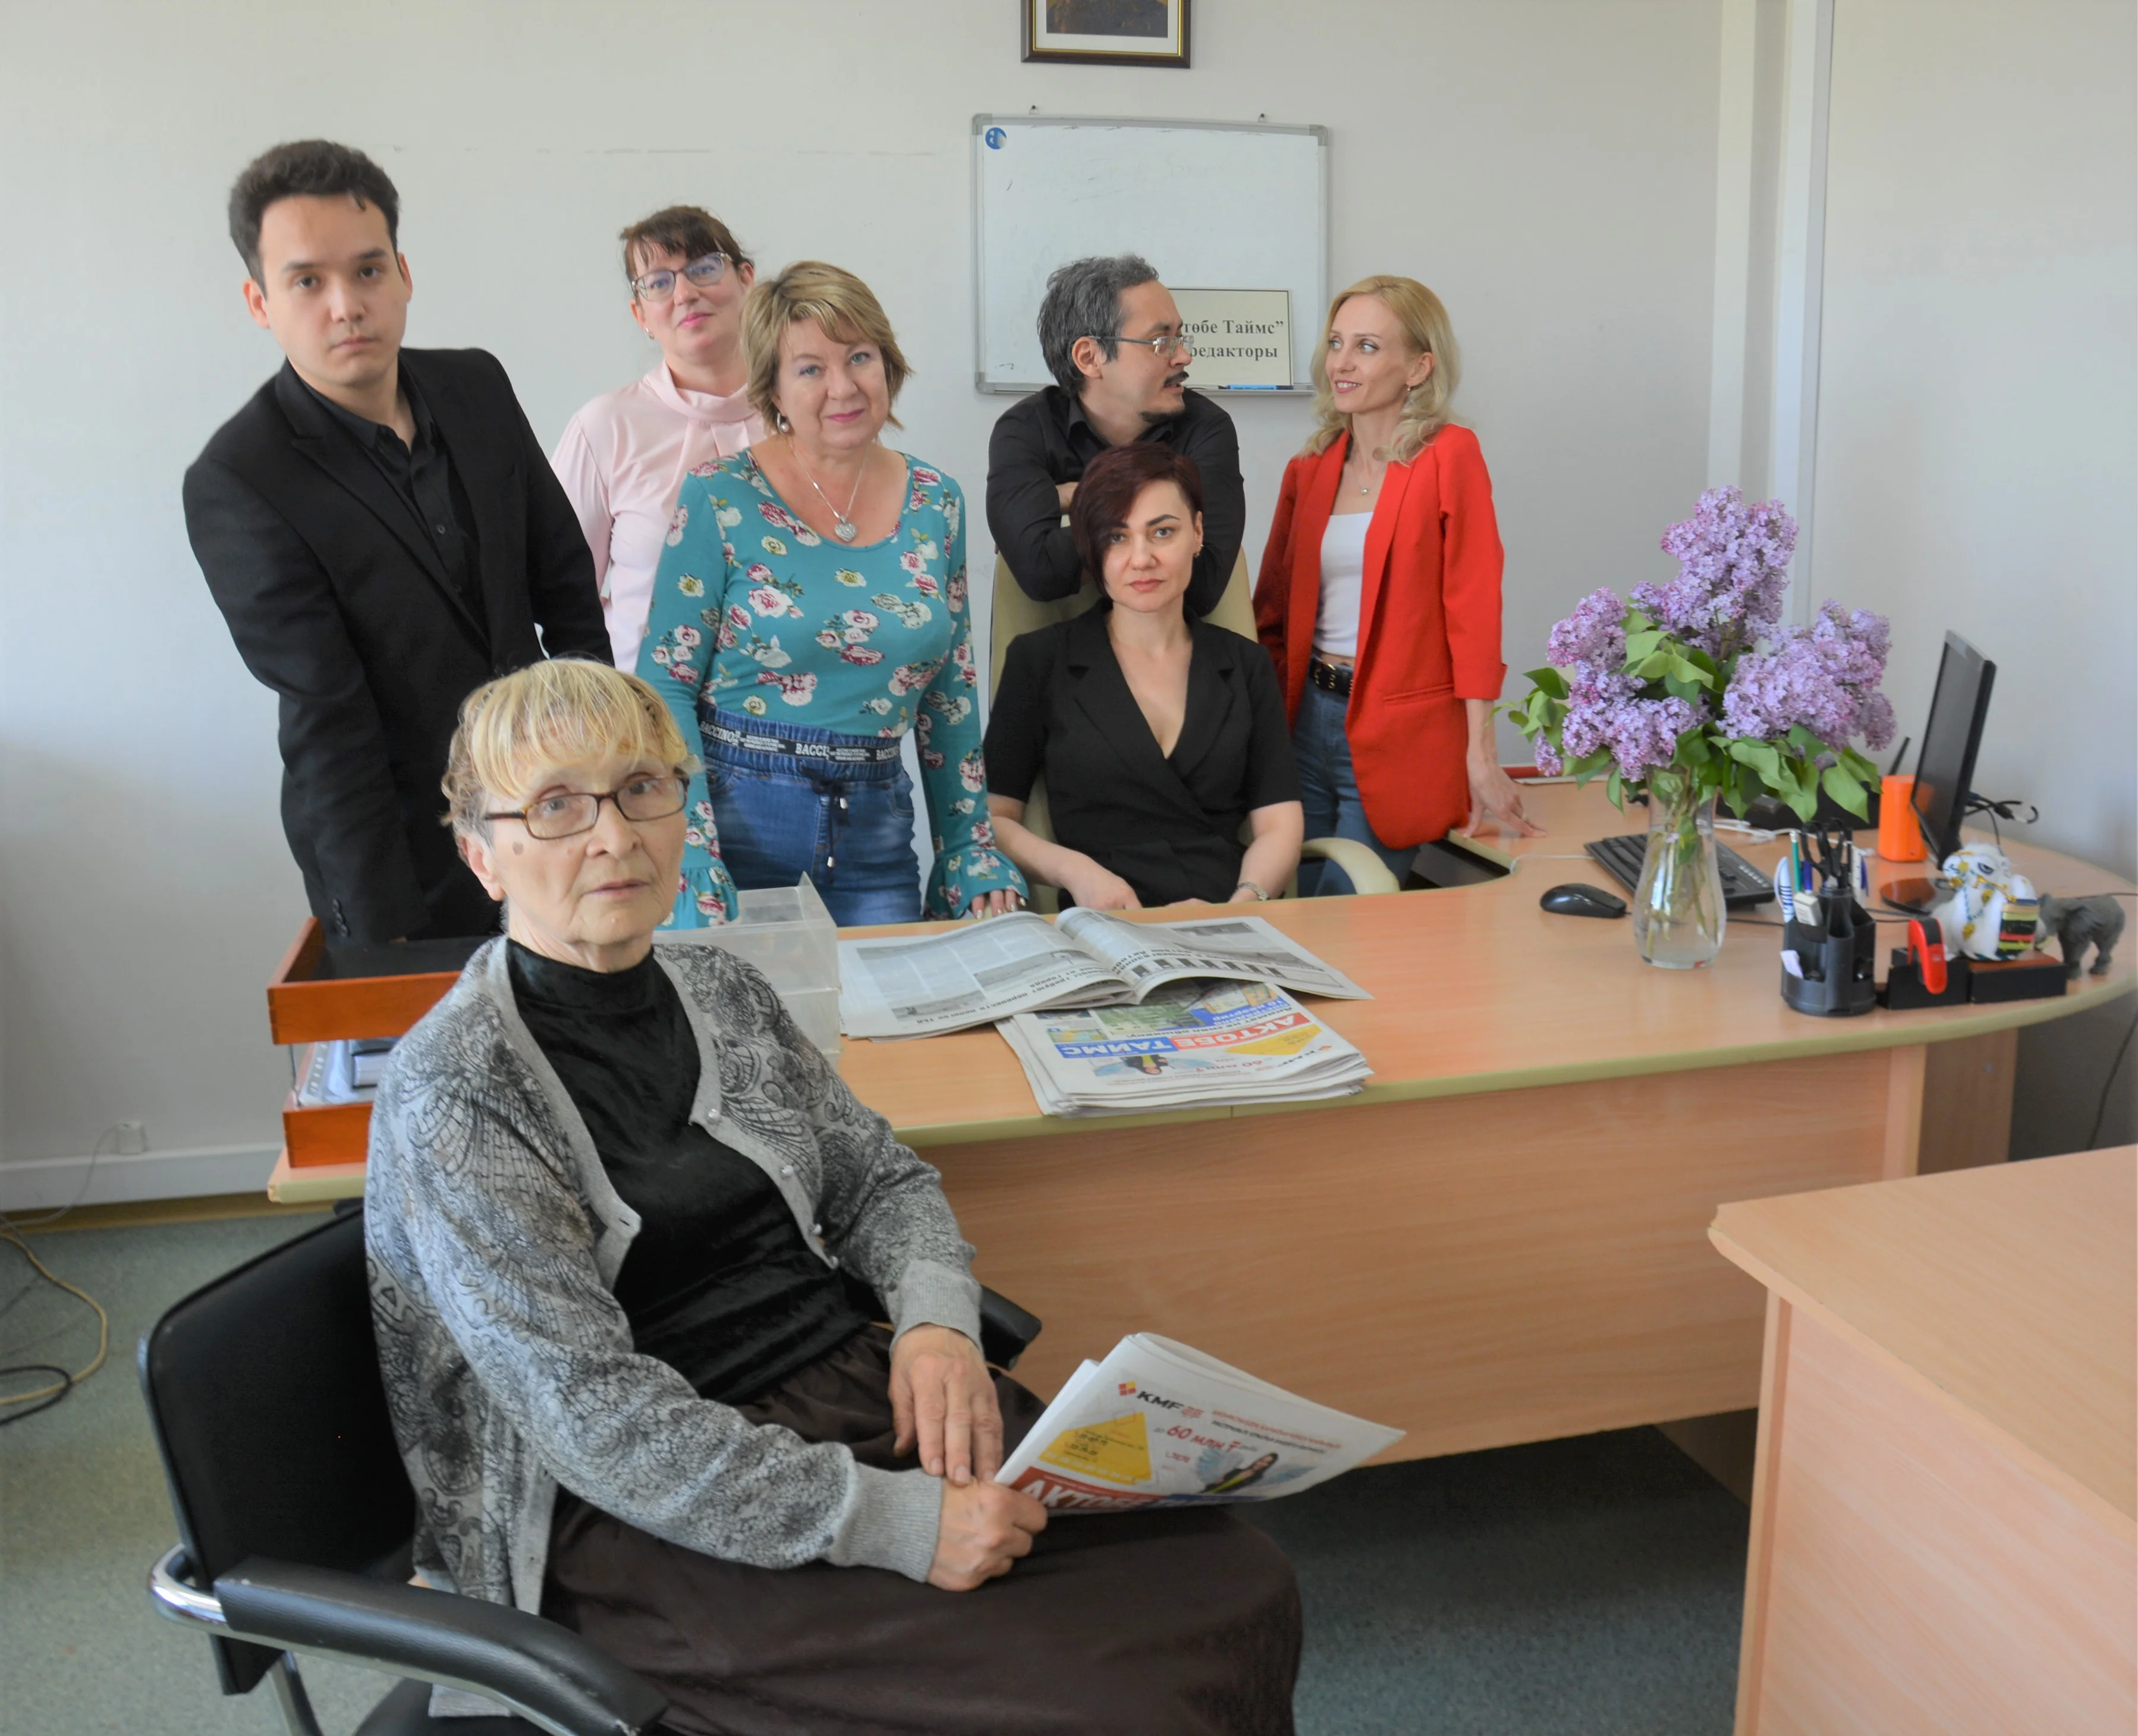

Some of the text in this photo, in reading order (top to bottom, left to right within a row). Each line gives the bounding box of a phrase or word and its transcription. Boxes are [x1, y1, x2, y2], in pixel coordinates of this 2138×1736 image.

[1183, 319, 1218, 334] төбе
[1173, 1014, 1295, 1047] АКТОБЕ
[1137, 1391, 1184, 1409] KMF
[1167, 1425, 1193, 1439] 60
